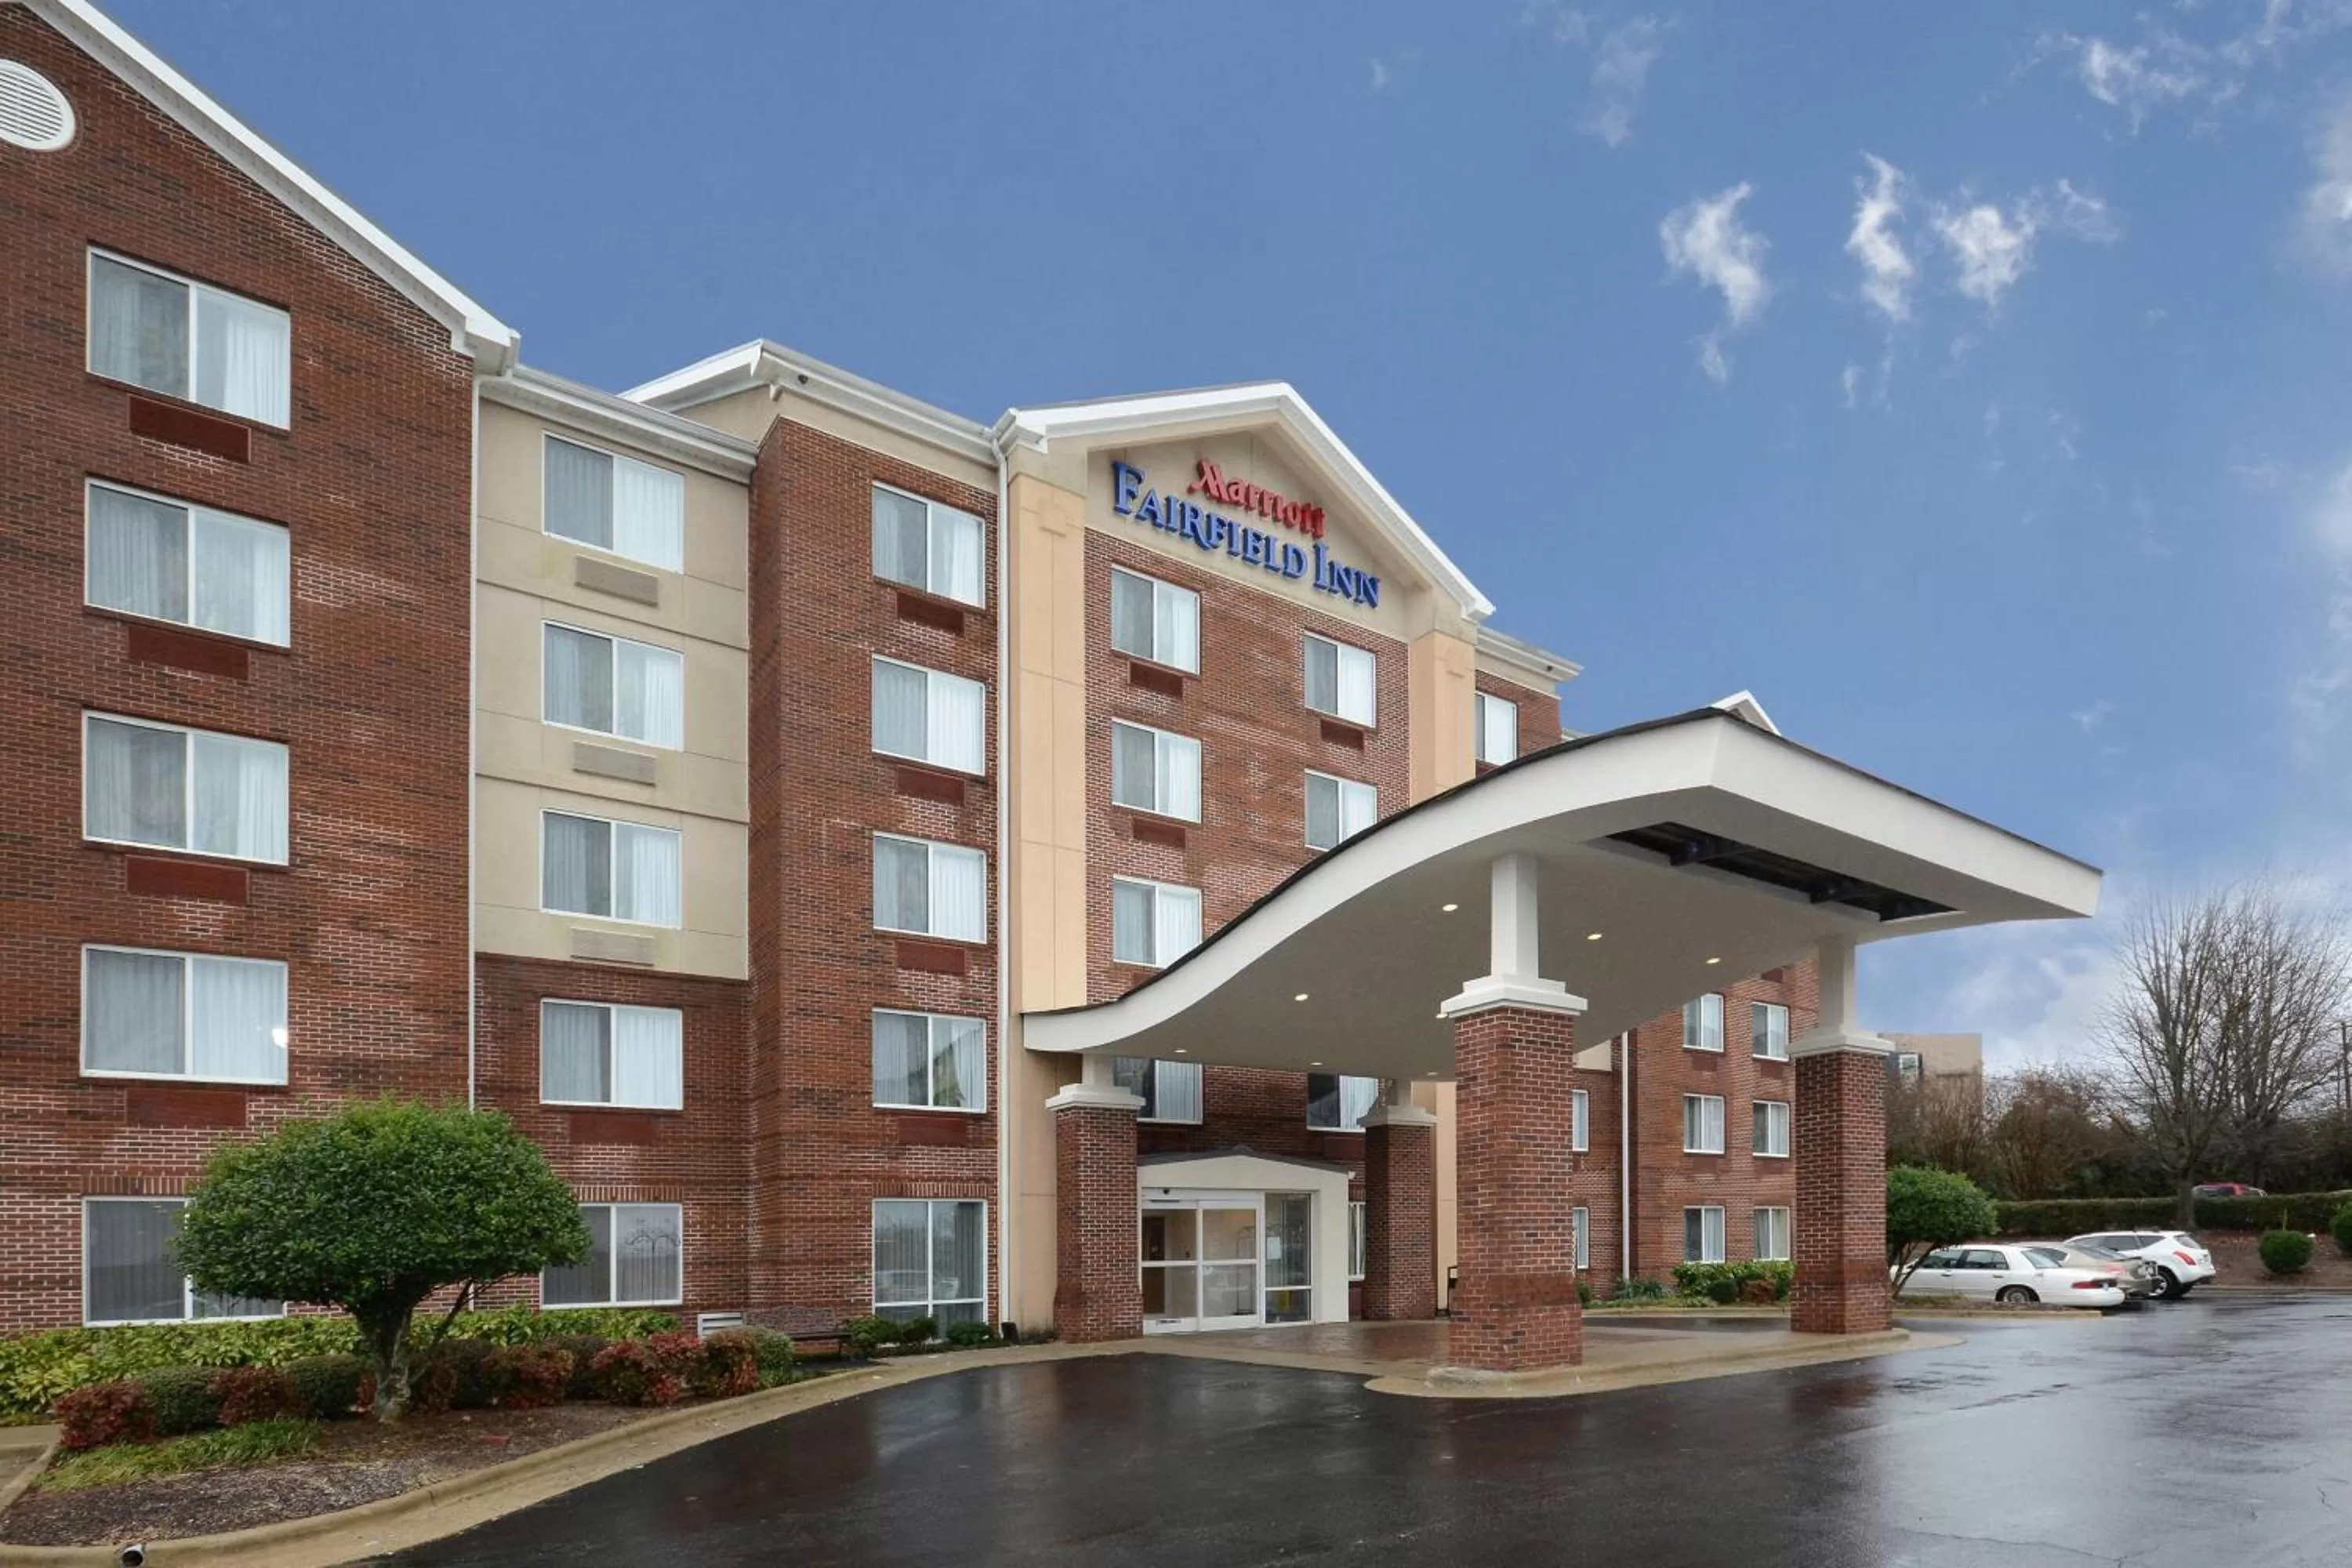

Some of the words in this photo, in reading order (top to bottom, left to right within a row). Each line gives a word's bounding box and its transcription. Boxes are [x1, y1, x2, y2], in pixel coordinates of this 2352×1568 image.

[1112, 460, 1308, 579] FAIRFIELD
[1313, 542, 1381, 609] INN
[1187, 458, 1326, 539] Marriott
